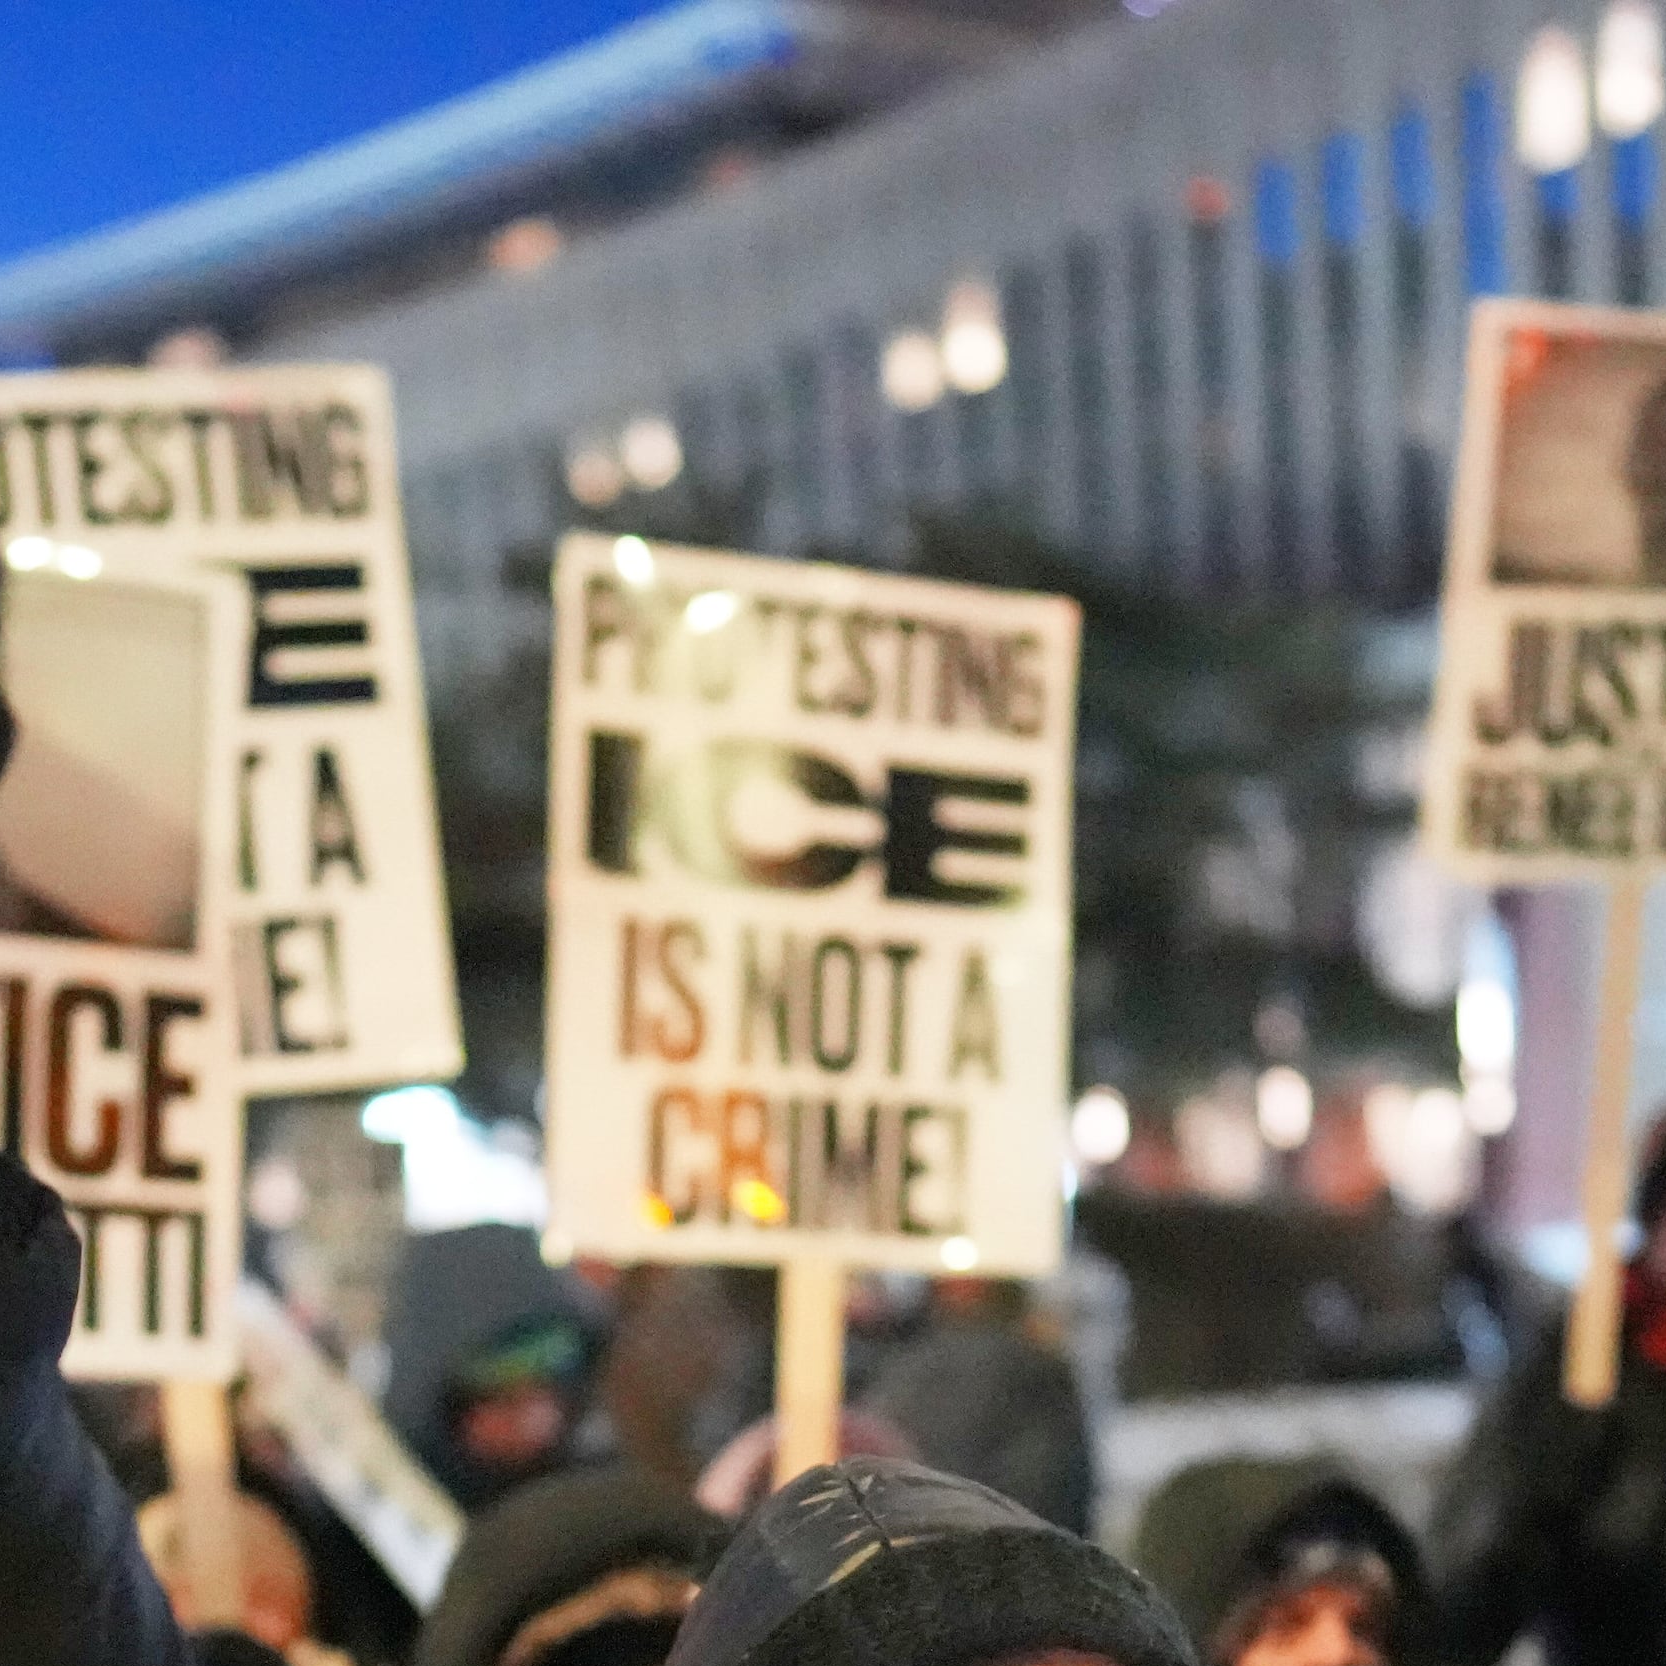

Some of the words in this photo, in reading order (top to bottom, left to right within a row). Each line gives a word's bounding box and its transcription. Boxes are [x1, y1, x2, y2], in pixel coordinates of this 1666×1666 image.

[587, 730, 1031, 908] ICE
[617, 913, 709, 1063] IS
[736, 922, 923, 1077] NOT
[944, 943, 1005, 1085] A
[645, 1085, 969, 1238] CRIME!
